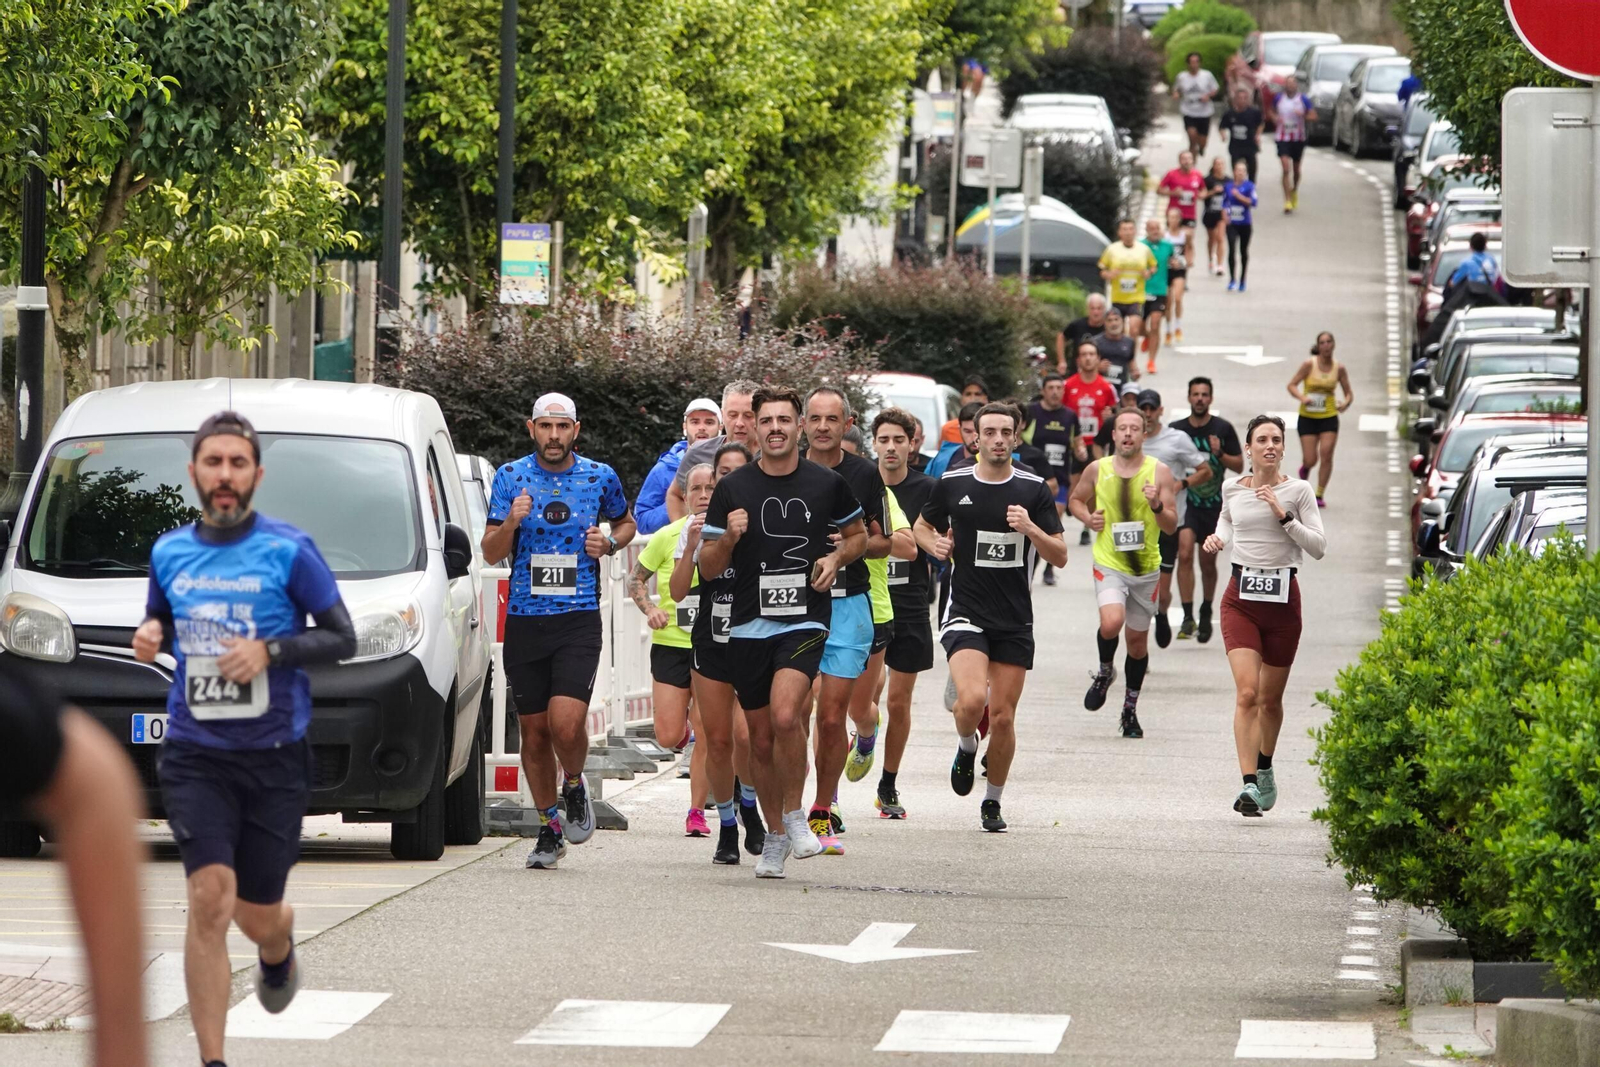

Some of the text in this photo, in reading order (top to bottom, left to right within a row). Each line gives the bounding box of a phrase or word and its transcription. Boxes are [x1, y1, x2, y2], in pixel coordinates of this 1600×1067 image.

[1119, 531, 1138, 543] 631
[987, 544, 1006, 558] 43
[541, 567, 564, 584] 211
[1246, 577, 1274, 592] 258
[767, 587, 798, 605] 232
[687, 607, 700, 622] 9
[193, 676, 240, 702] 244
[150, 718, 170, 740] 0
